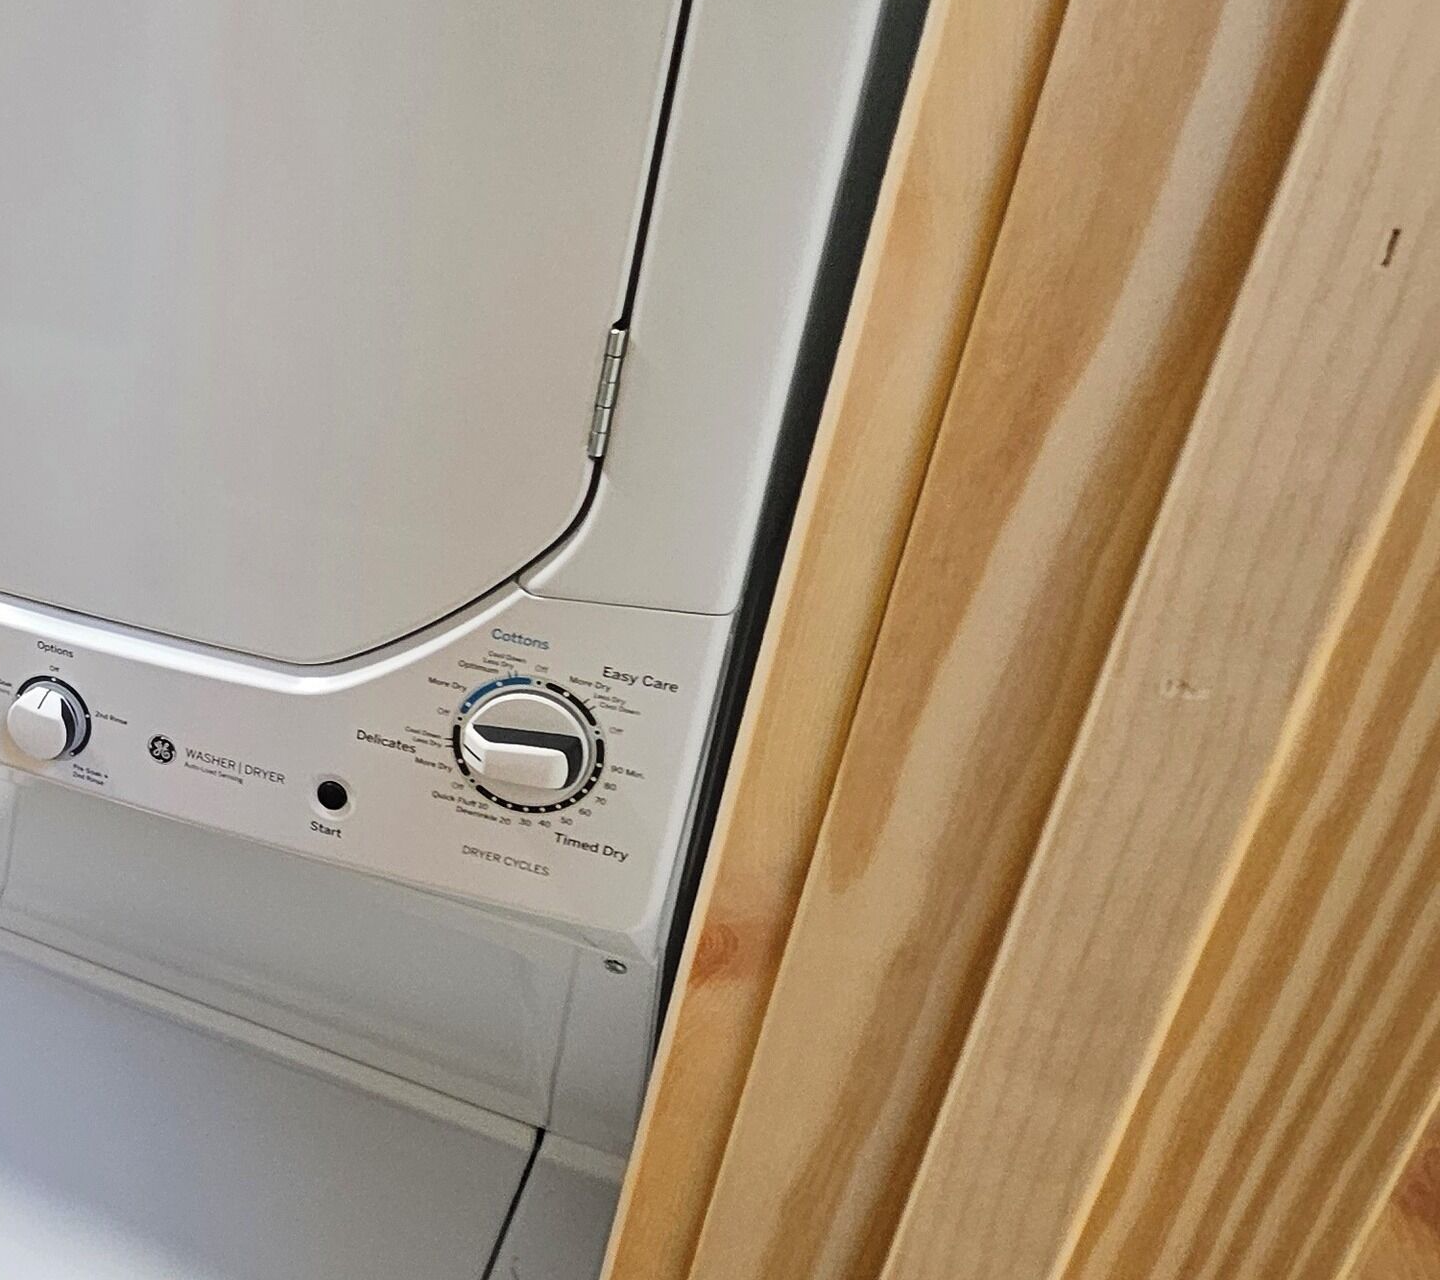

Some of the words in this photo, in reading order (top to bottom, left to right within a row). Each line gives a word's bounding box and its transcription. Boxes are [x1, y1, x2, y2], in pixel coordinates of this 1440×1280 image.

[491, 627, 550, 651] Cottons
[37, 640, 74, 658] Options
[458, 659, 500, 674] Optimum
[428, 676, 450, 688] More
[451, 681, 467, 693] Dry
[569, 676, 593, 688] More
[595, 681, 612, 693] Dry
[602, 666, 640, 686] Easy
[642, 675, 679, 693] Care
[95, 711, 109, 720] 2nd
[110, 714, 128, 725] Rinse
[357, 729, 416, 755] Delicates
[185, 747, 236, 771] WASHER
[244, 764, 286, 785] DRYER
[415, 756, 436, 768] More
[437, 761, 453, 773] Dry
[611, 765, 624, 774] 90
[604, 782, 617, 791] 80
[432, 790, 455, 802] Quick
[595, 796, 607, 806] 70
[579, 808, 592, 817] 60
[498, 816, 512, 826] 20
[519, 817, 532, 827] 30
[538, 819, 551, 828] 40
[560, 816, 573, 826] 50
[310, 821, 342, 839] Start
[554, 832, 599, 854] Timed
[602, 845, 629, 863] Dry
[462, 845, 502, 863] DRYER
[503, 856, 550, 877] CYCLES
